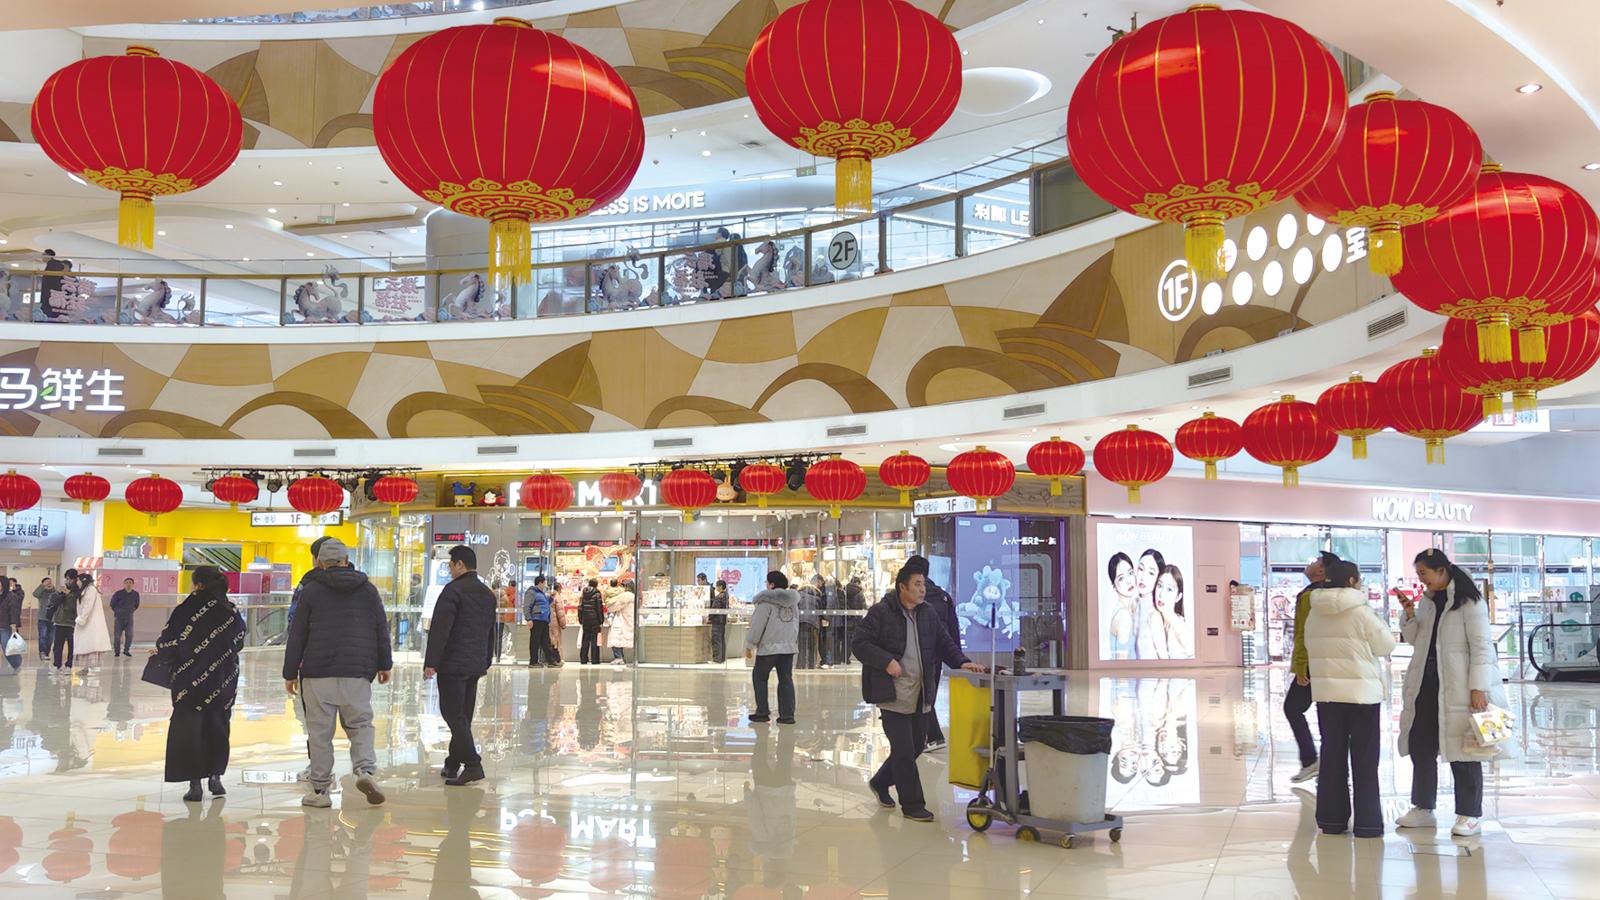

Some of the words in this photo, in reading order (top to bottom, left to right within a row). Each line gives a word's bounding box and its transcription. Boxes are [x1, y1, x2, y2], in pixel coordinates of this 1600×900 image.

[634, 195, 649, 212] IS
[832, 239, 854, 263] 2F
[1164, 272, 1190, 311] 1F
[0, 368, 125, 411] 马鲜生
[946, 499, 957, 511] 1F
[1372, 497, 1412, 521] WOW
[1415, 501, 1473, 521] BEAUTY
[290, 514, 302, 523] 1F
[191, 606, 209, 622] BACK
[194, 638, 210, 654] BACK
[192, 671, 209, 687] BACK
